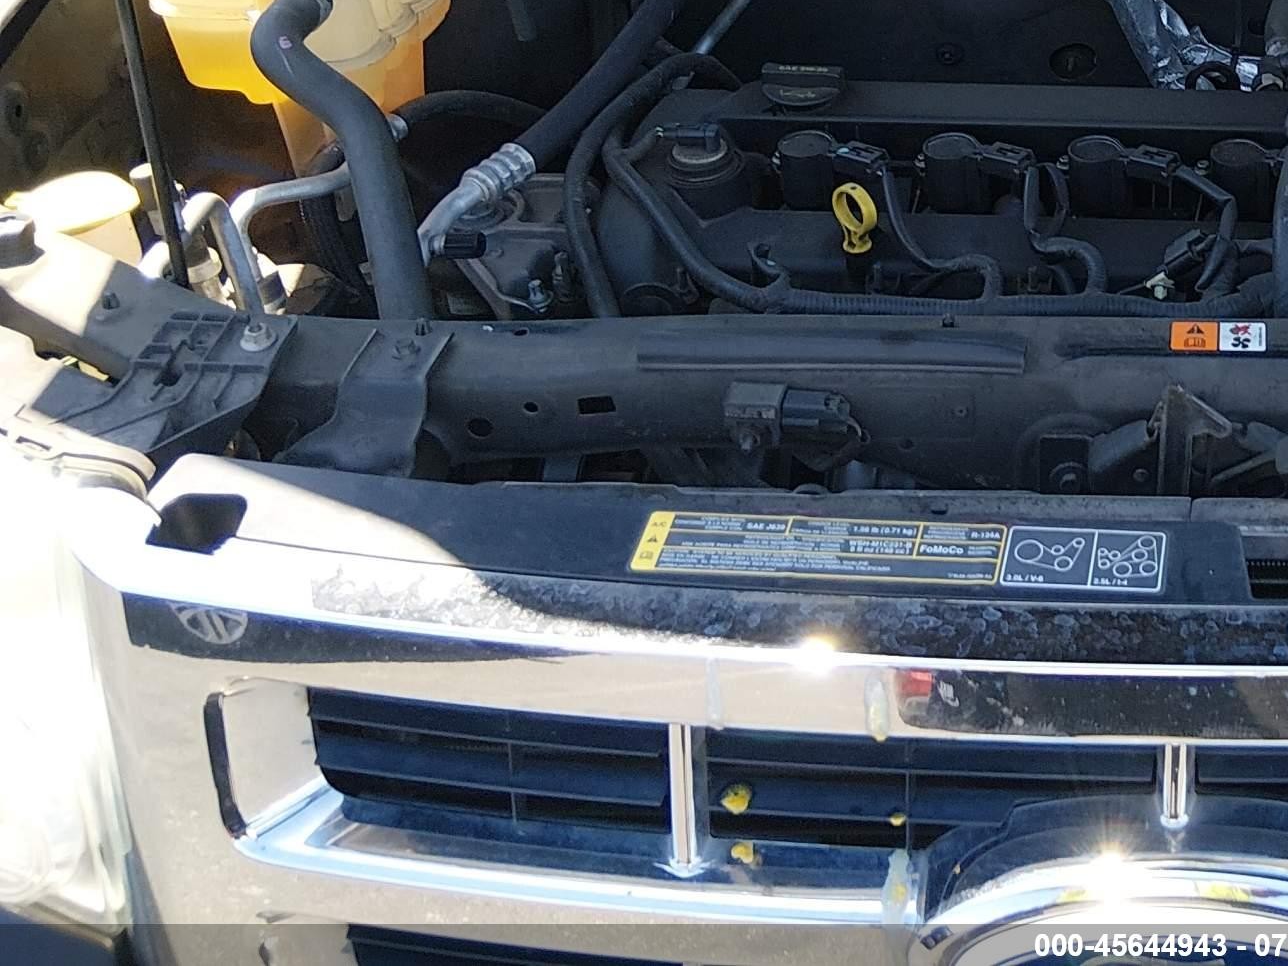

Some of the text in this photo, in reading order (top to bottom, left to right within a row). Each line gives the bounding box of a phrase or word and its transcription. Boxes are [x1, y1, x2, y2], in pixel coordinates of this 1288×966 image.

[746, 522, 764, 530] SAE
[971, 531, 1001, 539] R-134A
[919, 544, 964, 555] FoMoCo
[1005, 573, 1024, 581] 3.0L
